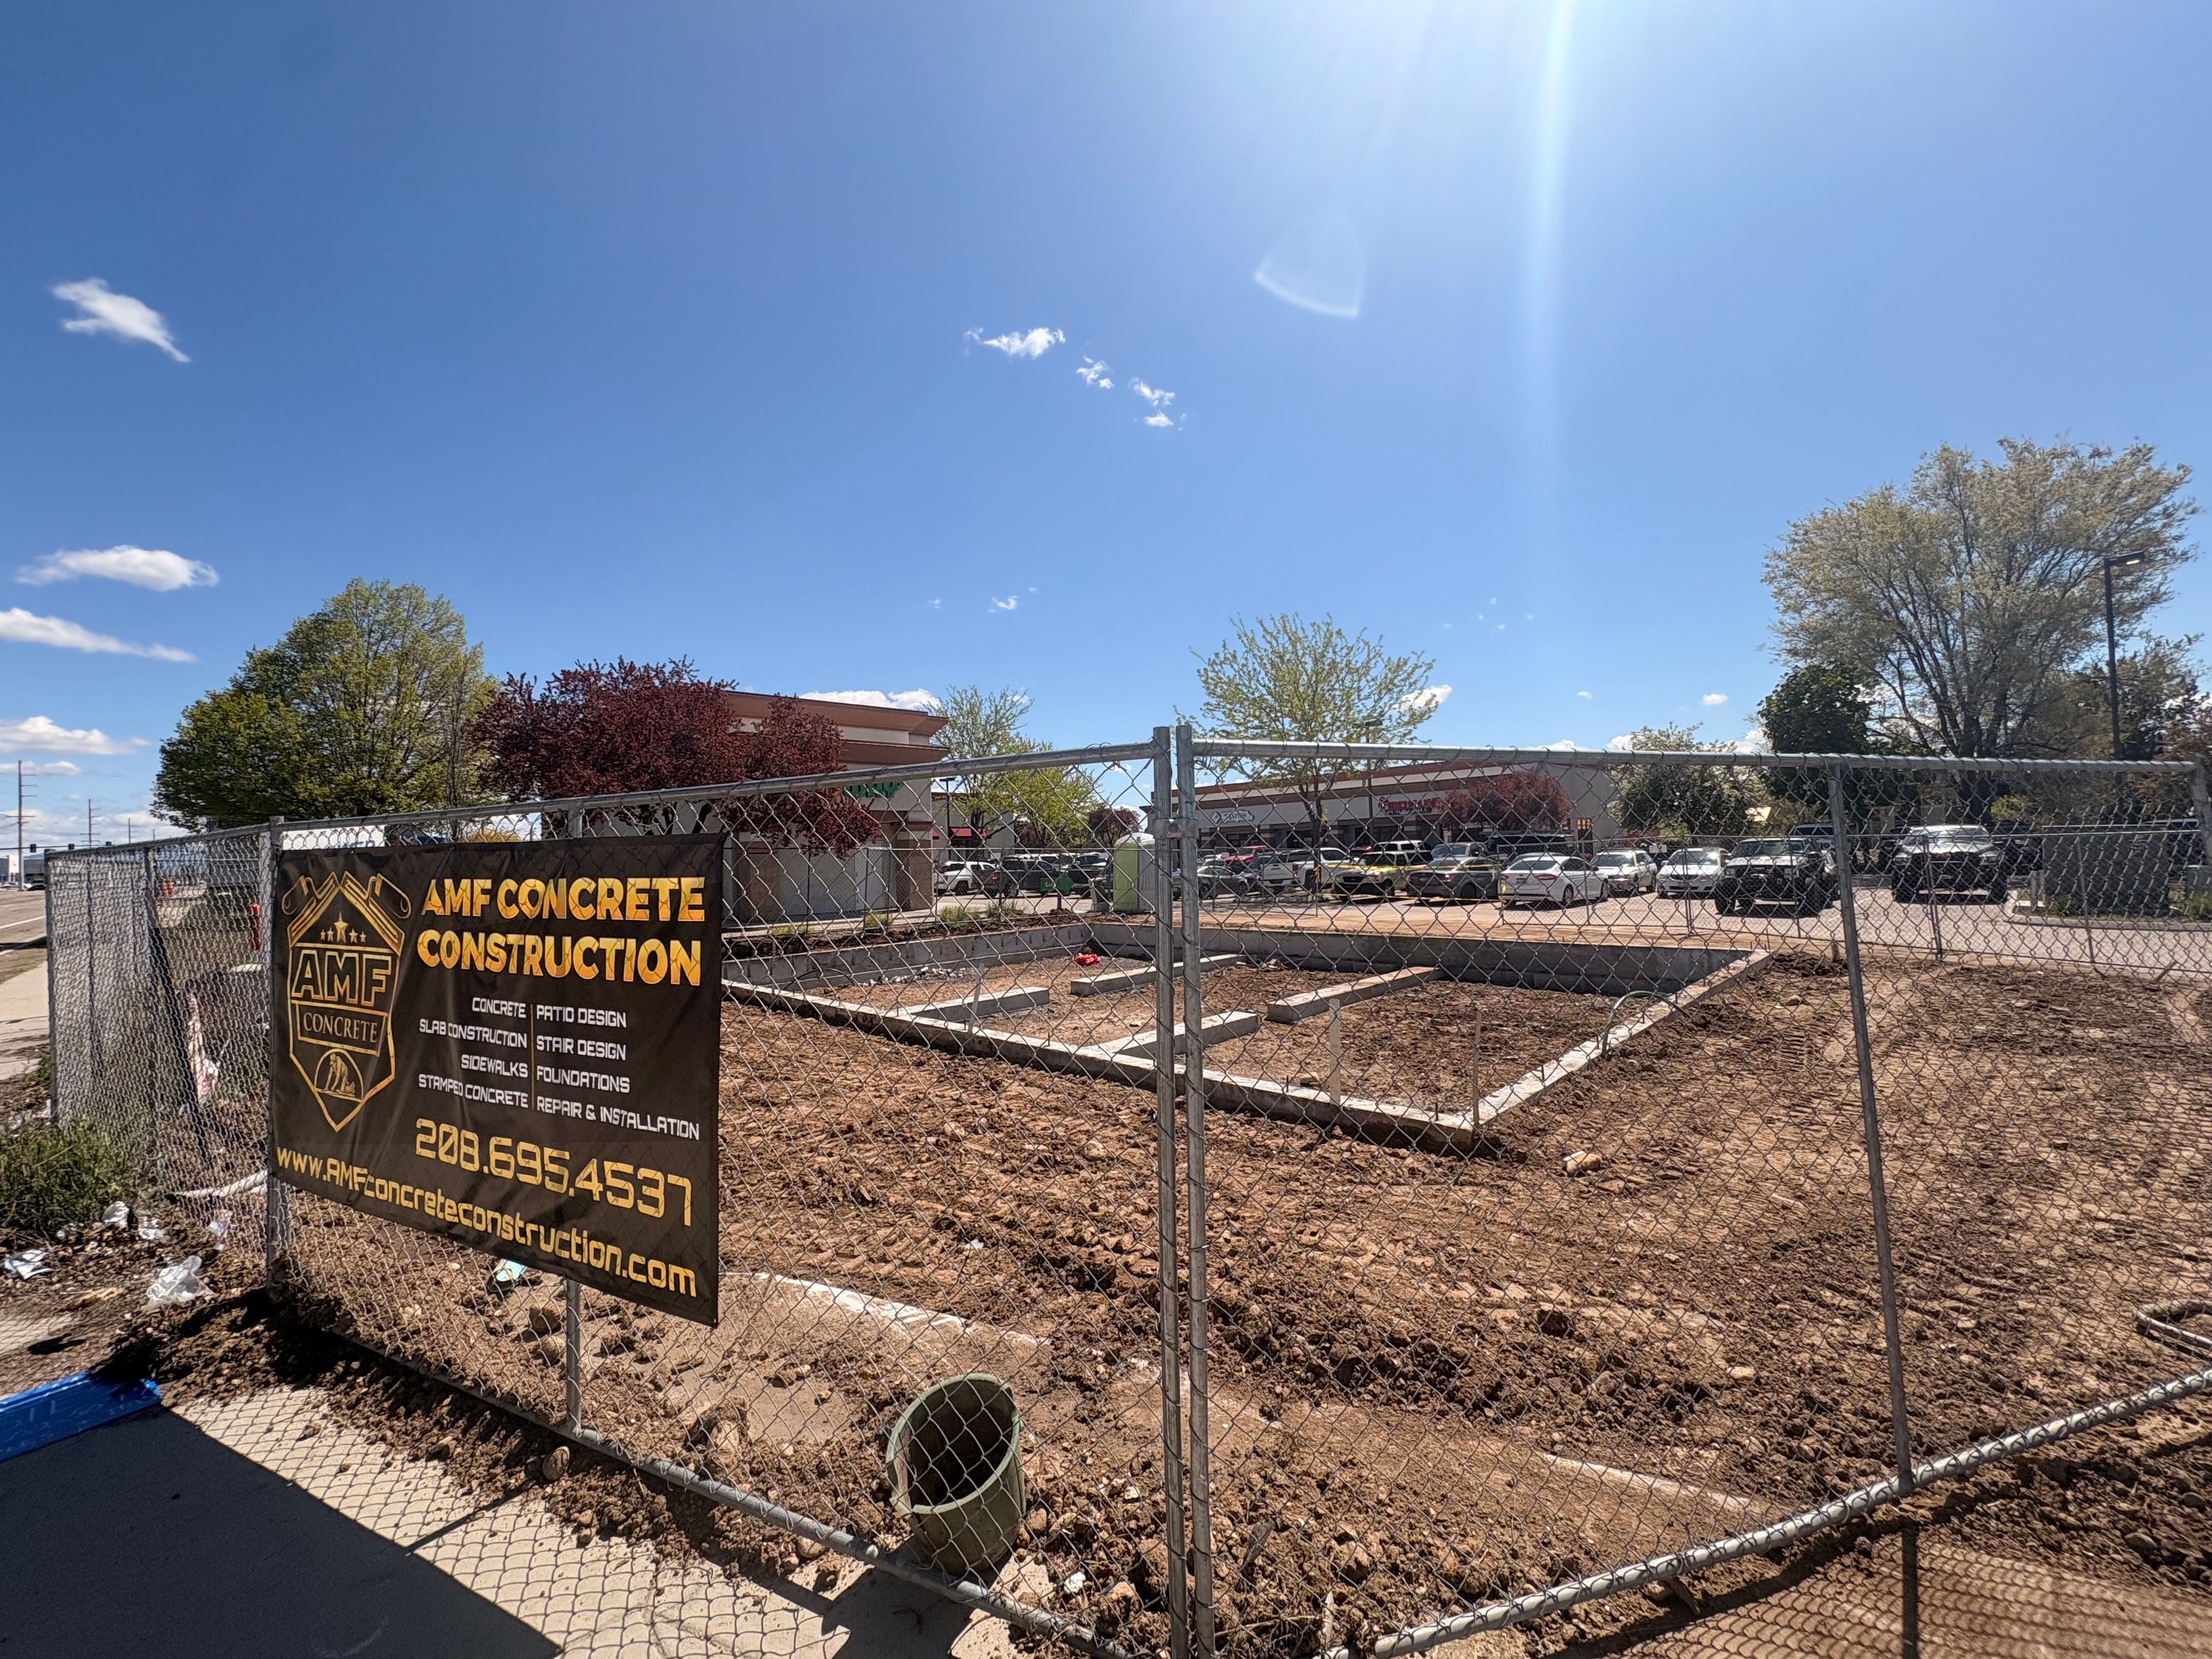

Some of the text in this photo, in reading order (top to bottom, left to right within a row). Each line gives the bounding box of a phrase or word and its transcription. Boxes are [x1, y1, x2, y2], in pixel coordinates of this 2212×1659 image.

[421, 876, 706, 922] AMF CONCRETE
[417, 929, 701, 986] CONSTRUCTION
[291, 949, 392, 1007] AMF
[472, 997, 527, 1019] CONCRETE
[537, 1005, 627, 1028] PATIO DESIGN
[303, 1012, 378, 1043] CONCRETE
[419, 1018, 527, 1048] SLAB CONSTRUCTION
[537, 1035, 627, 1061] STAIR DESIGN
[461, 1054, 528, 1078] SIDEWALKS
[537, 1065, 630, 1093] FOUNDATIONS
[419, 1074, 529, 1108] STAMPED CONCRETE
[537, 1096, 700, 1141] REPAIR & INSTALLATION
[415, 1118, 692, 1227] 208.695.4537
[276, 1146, 697, 1298] www.AMFconcreteconstruction.com
